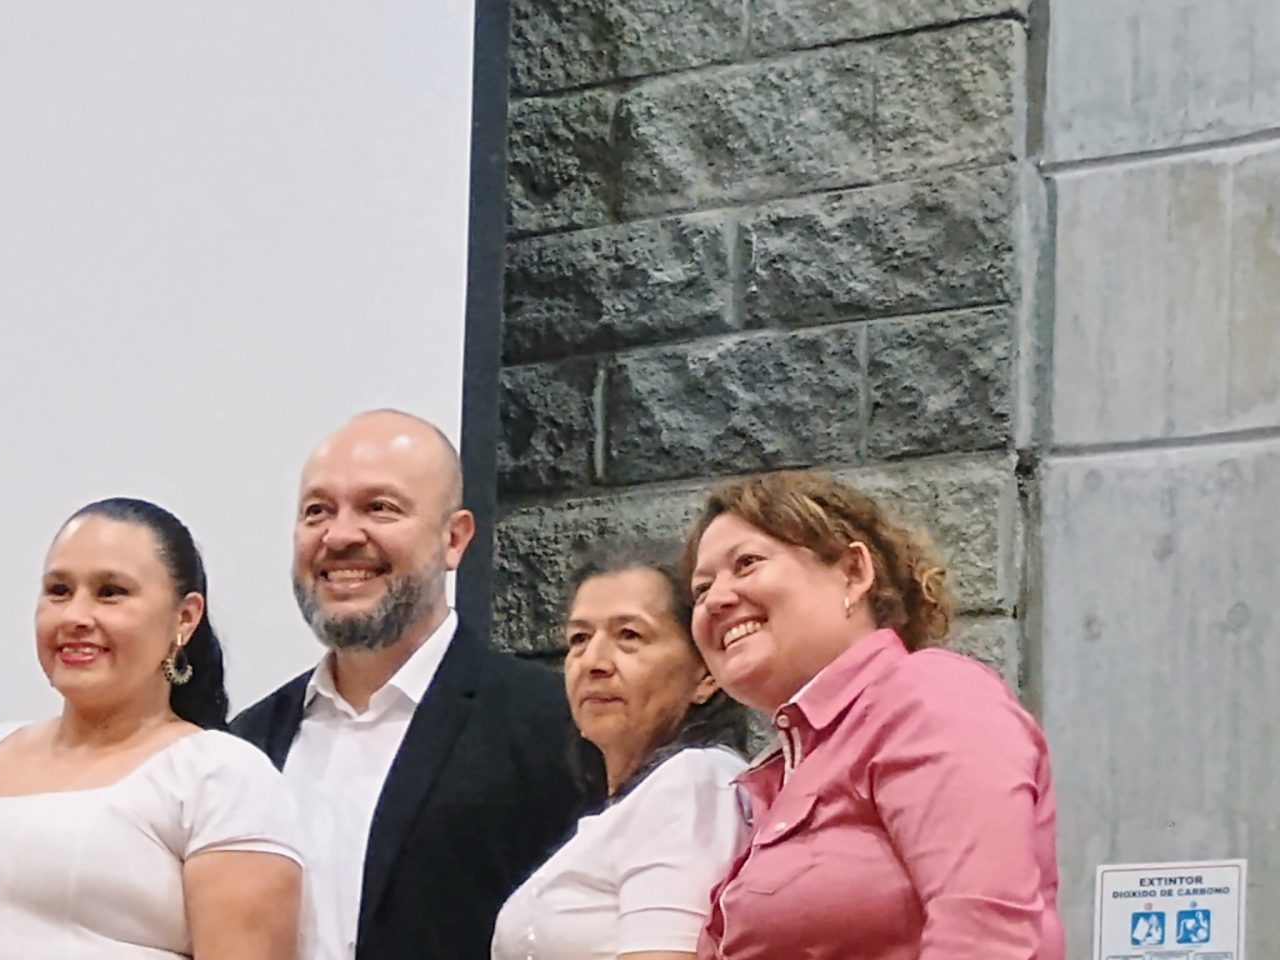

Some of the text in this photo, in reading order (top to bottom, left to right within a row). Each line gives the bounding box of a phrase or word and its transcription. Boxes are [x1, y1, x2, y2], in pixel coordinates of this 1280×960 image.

[1139, 875, 1204, 887] EXTINTOR
[1111, 889, 1157, 899] DIOXIDO
[1160, 888, 1173, 898] DE
